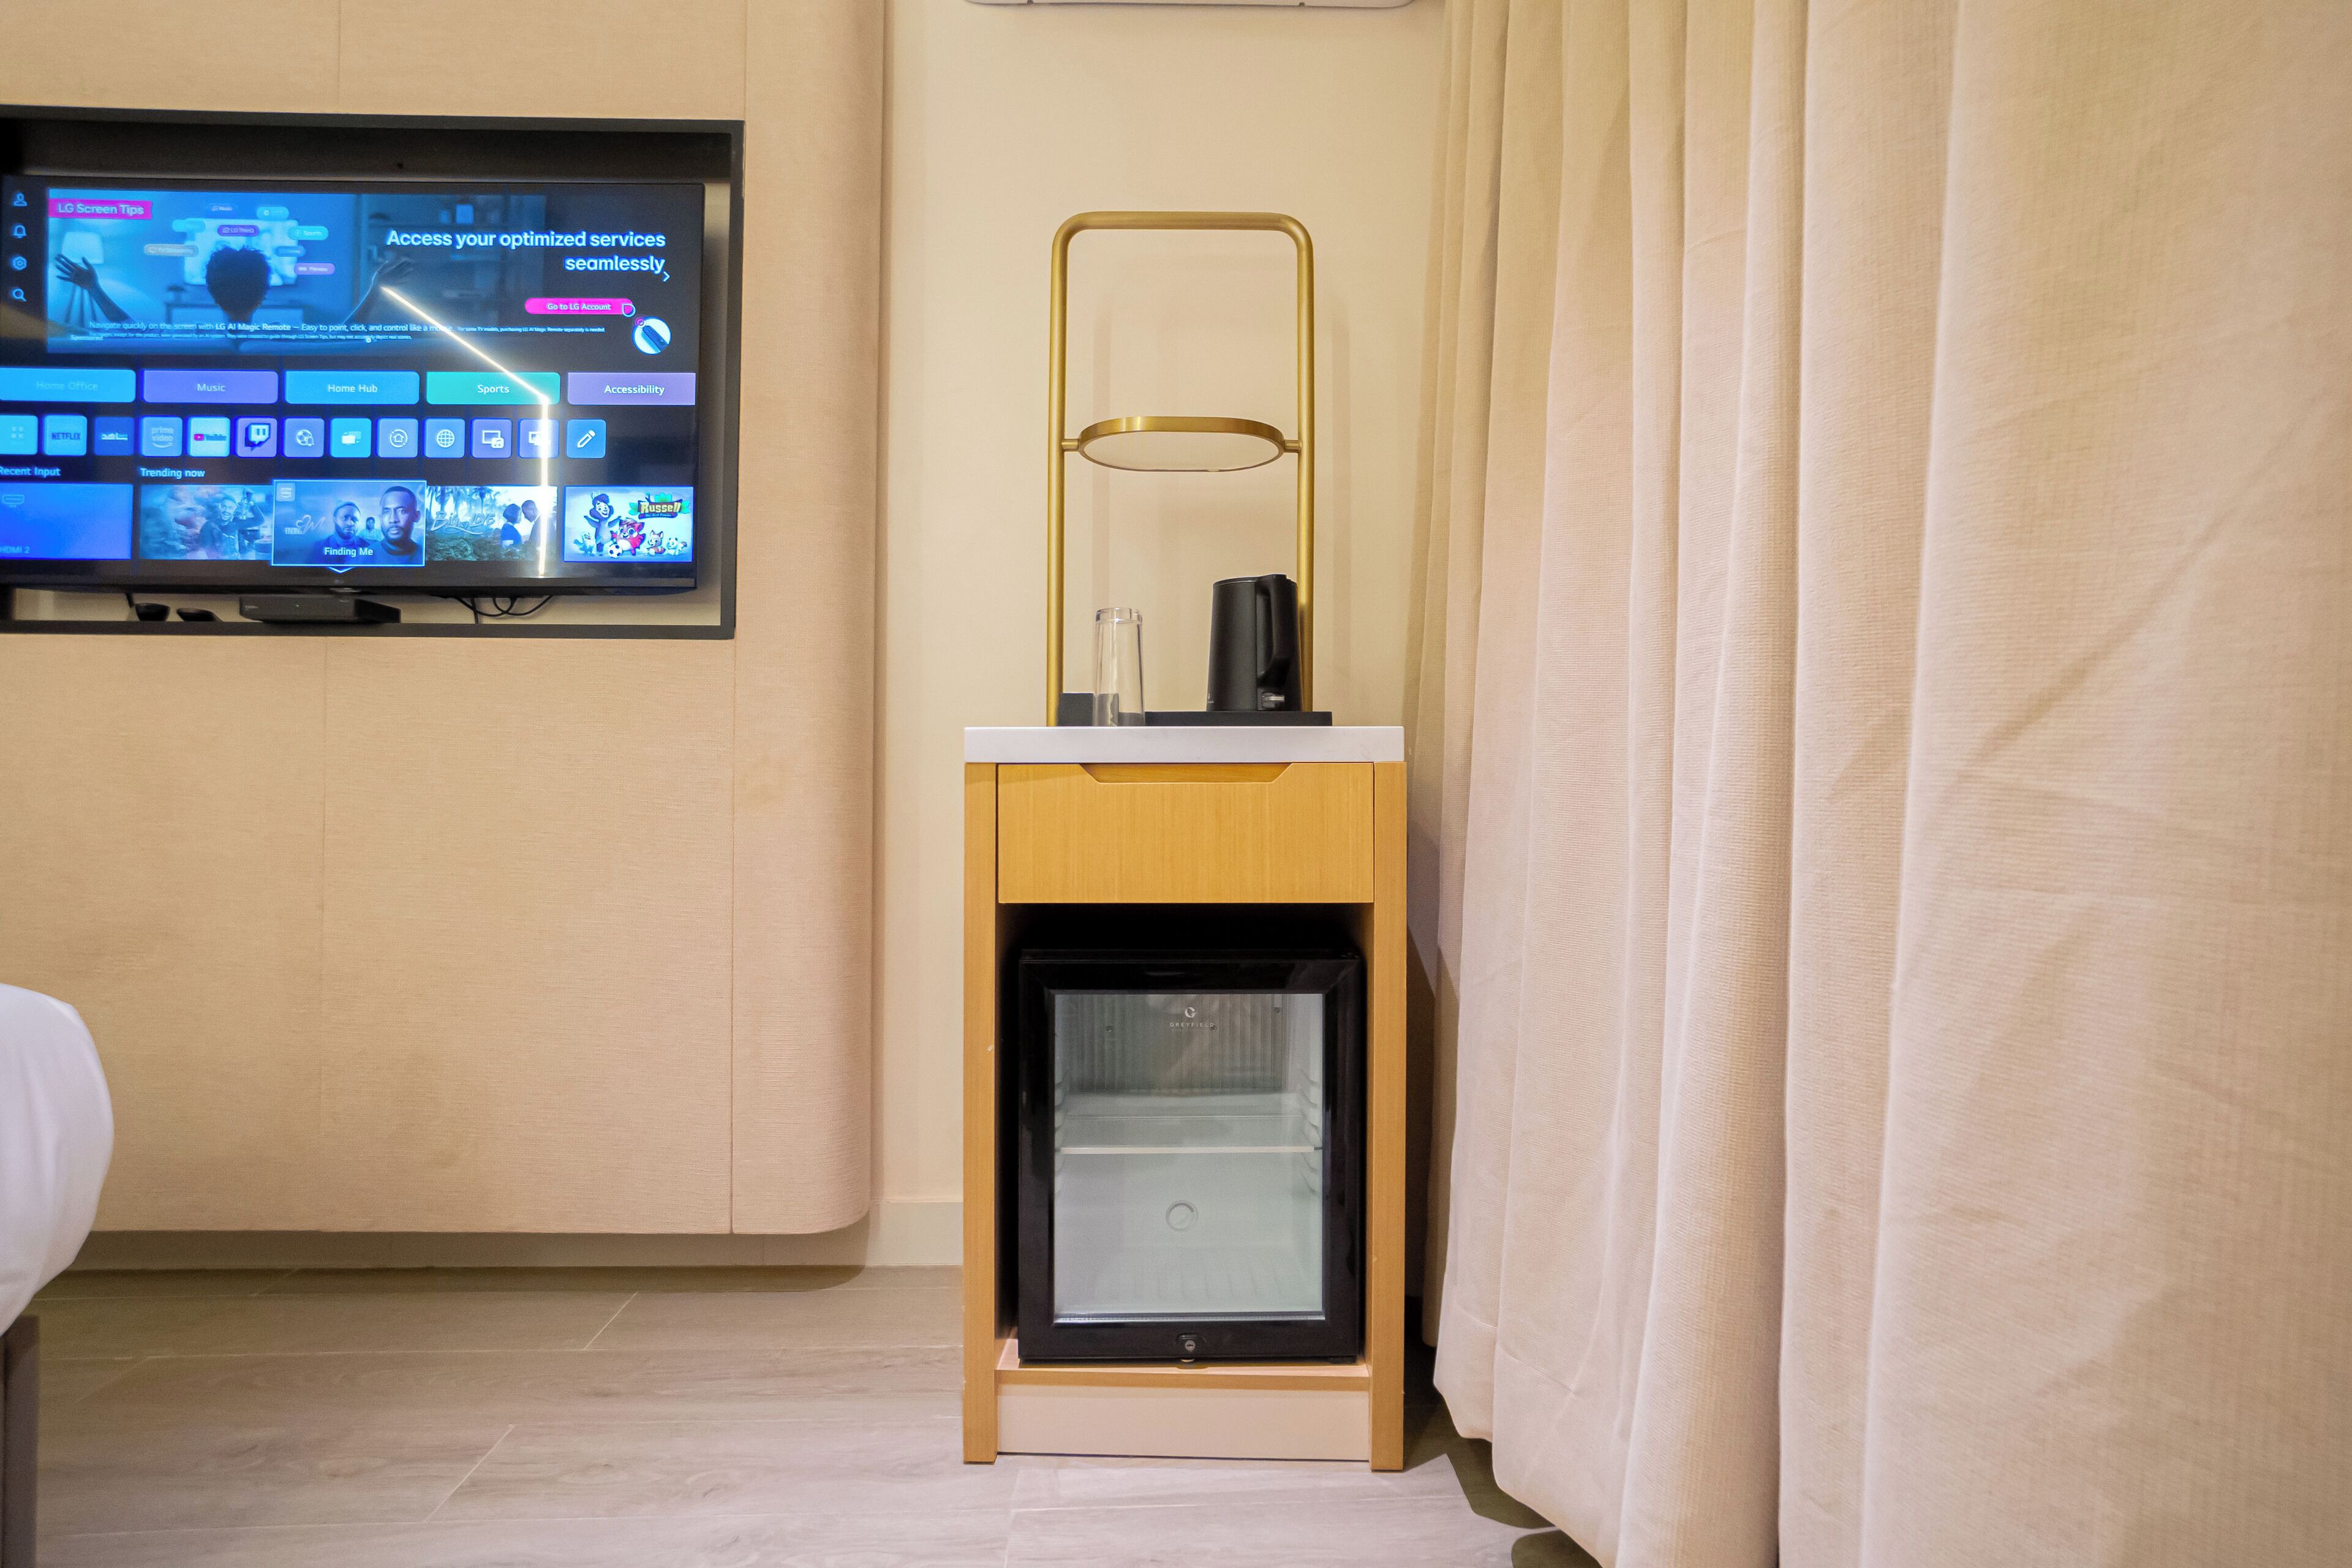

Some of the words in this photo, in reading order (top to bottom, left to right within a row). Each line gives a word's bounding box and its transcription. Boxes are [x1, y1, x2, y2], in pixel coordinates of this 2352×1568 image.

[58, 203, 74, 213] LG
[77, 204, 118, 214] Screen
[119, 204, 145, 216] Tips
[386, 230, 452, 246] Access
[456, 234, 497, 250] your
[500, 231, 587, 250] optimized
[590, 232, 666, 247] services
[565, 255, 665, 274] seamlessly
[89, 322, 121, 330] Navigate
[123, 322, 146, 331] quickly
[238, 323, 260, 332] Magic
[330, 324, 349, 333] point,
[36, 381, 65, 390] Home
[68, 381, 99, 391] Office
[197, 383, 226, 392] Music
[328, 384, 356, 393] Home
[358, 384, 379, 393] Hub
[477, 385, 510, 395] Sports
[604, 385, 666, 396] Accessibility
[151, 426, 174, 435] prime
[0, 467, 31, 476] Recent
[34, 467, 61, 478] Input
[140, 467, 182, 480] Trending
[640, 502, 682, 514] Russell
[324, 548, 357, 558] Finding
